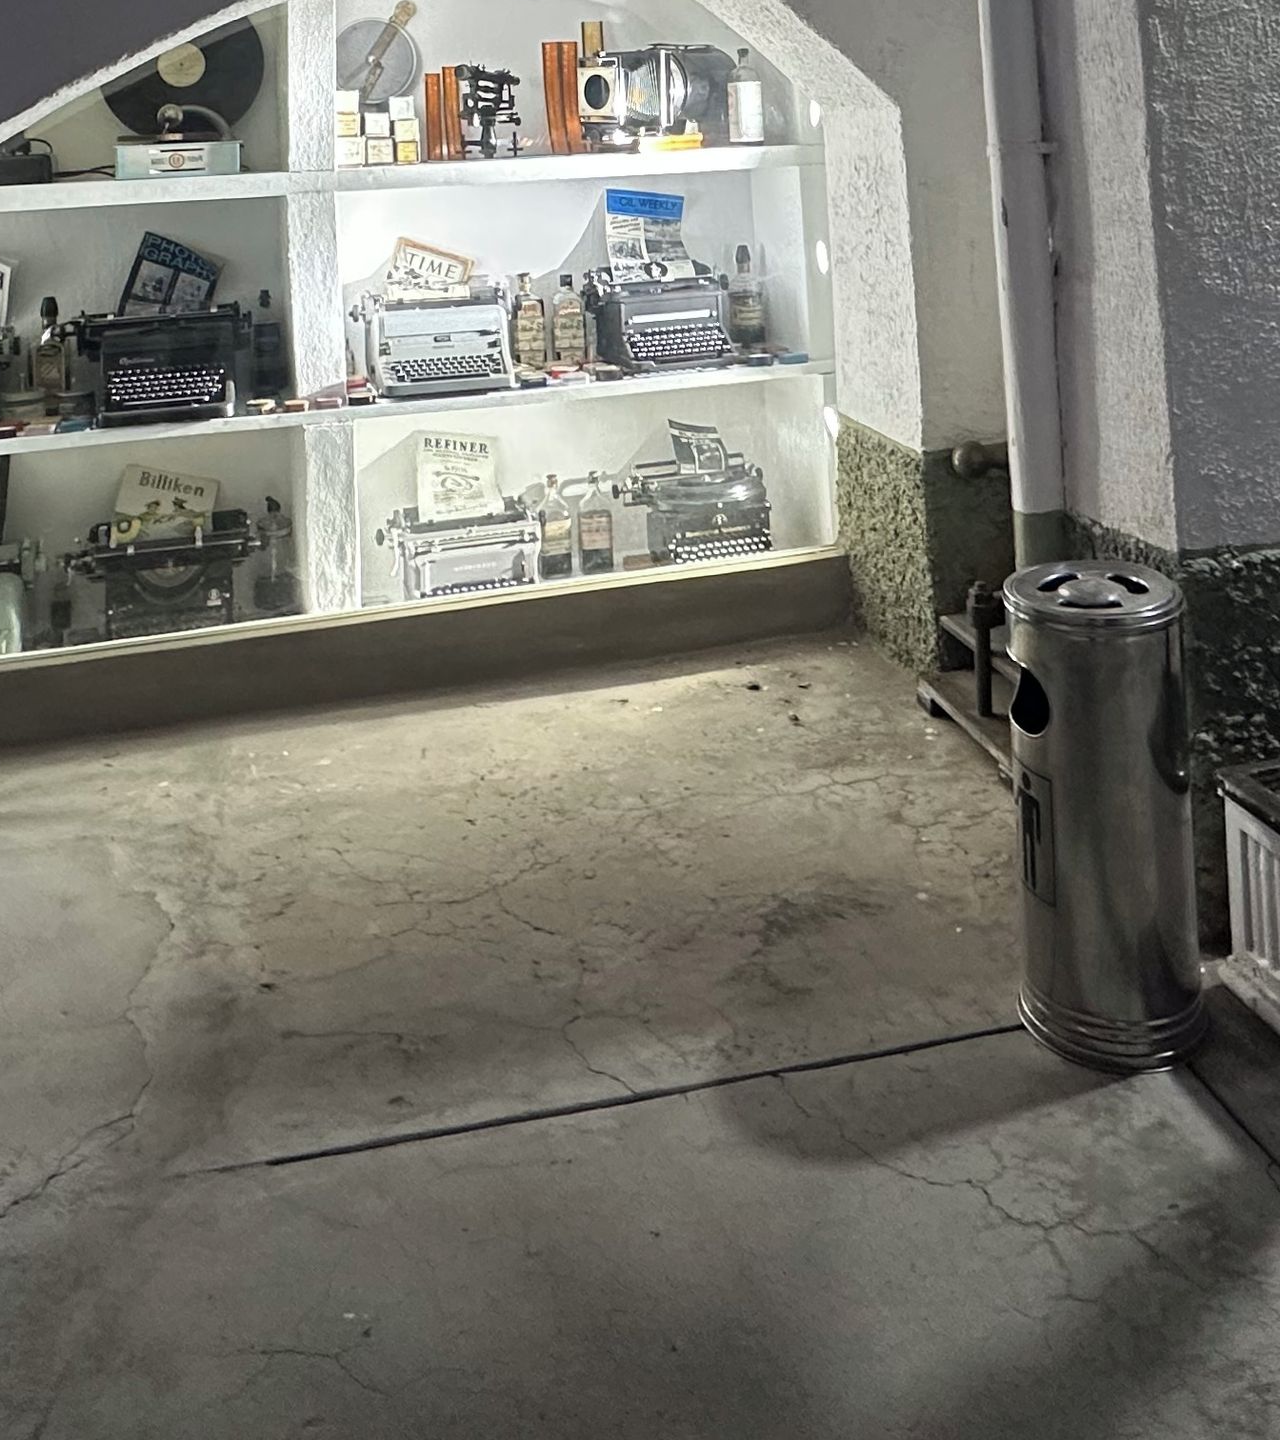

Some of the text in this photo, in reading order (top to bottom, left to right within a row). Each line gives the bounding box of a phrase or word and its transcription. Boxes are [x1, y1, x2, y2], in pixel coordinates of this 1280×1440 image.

[637, 198, 678, 210] WEEKLY
[407, 251, 459, 279] TIME
[423, 437, 489, 454] REFINER
[139, 471, 205, 497] Billiken
